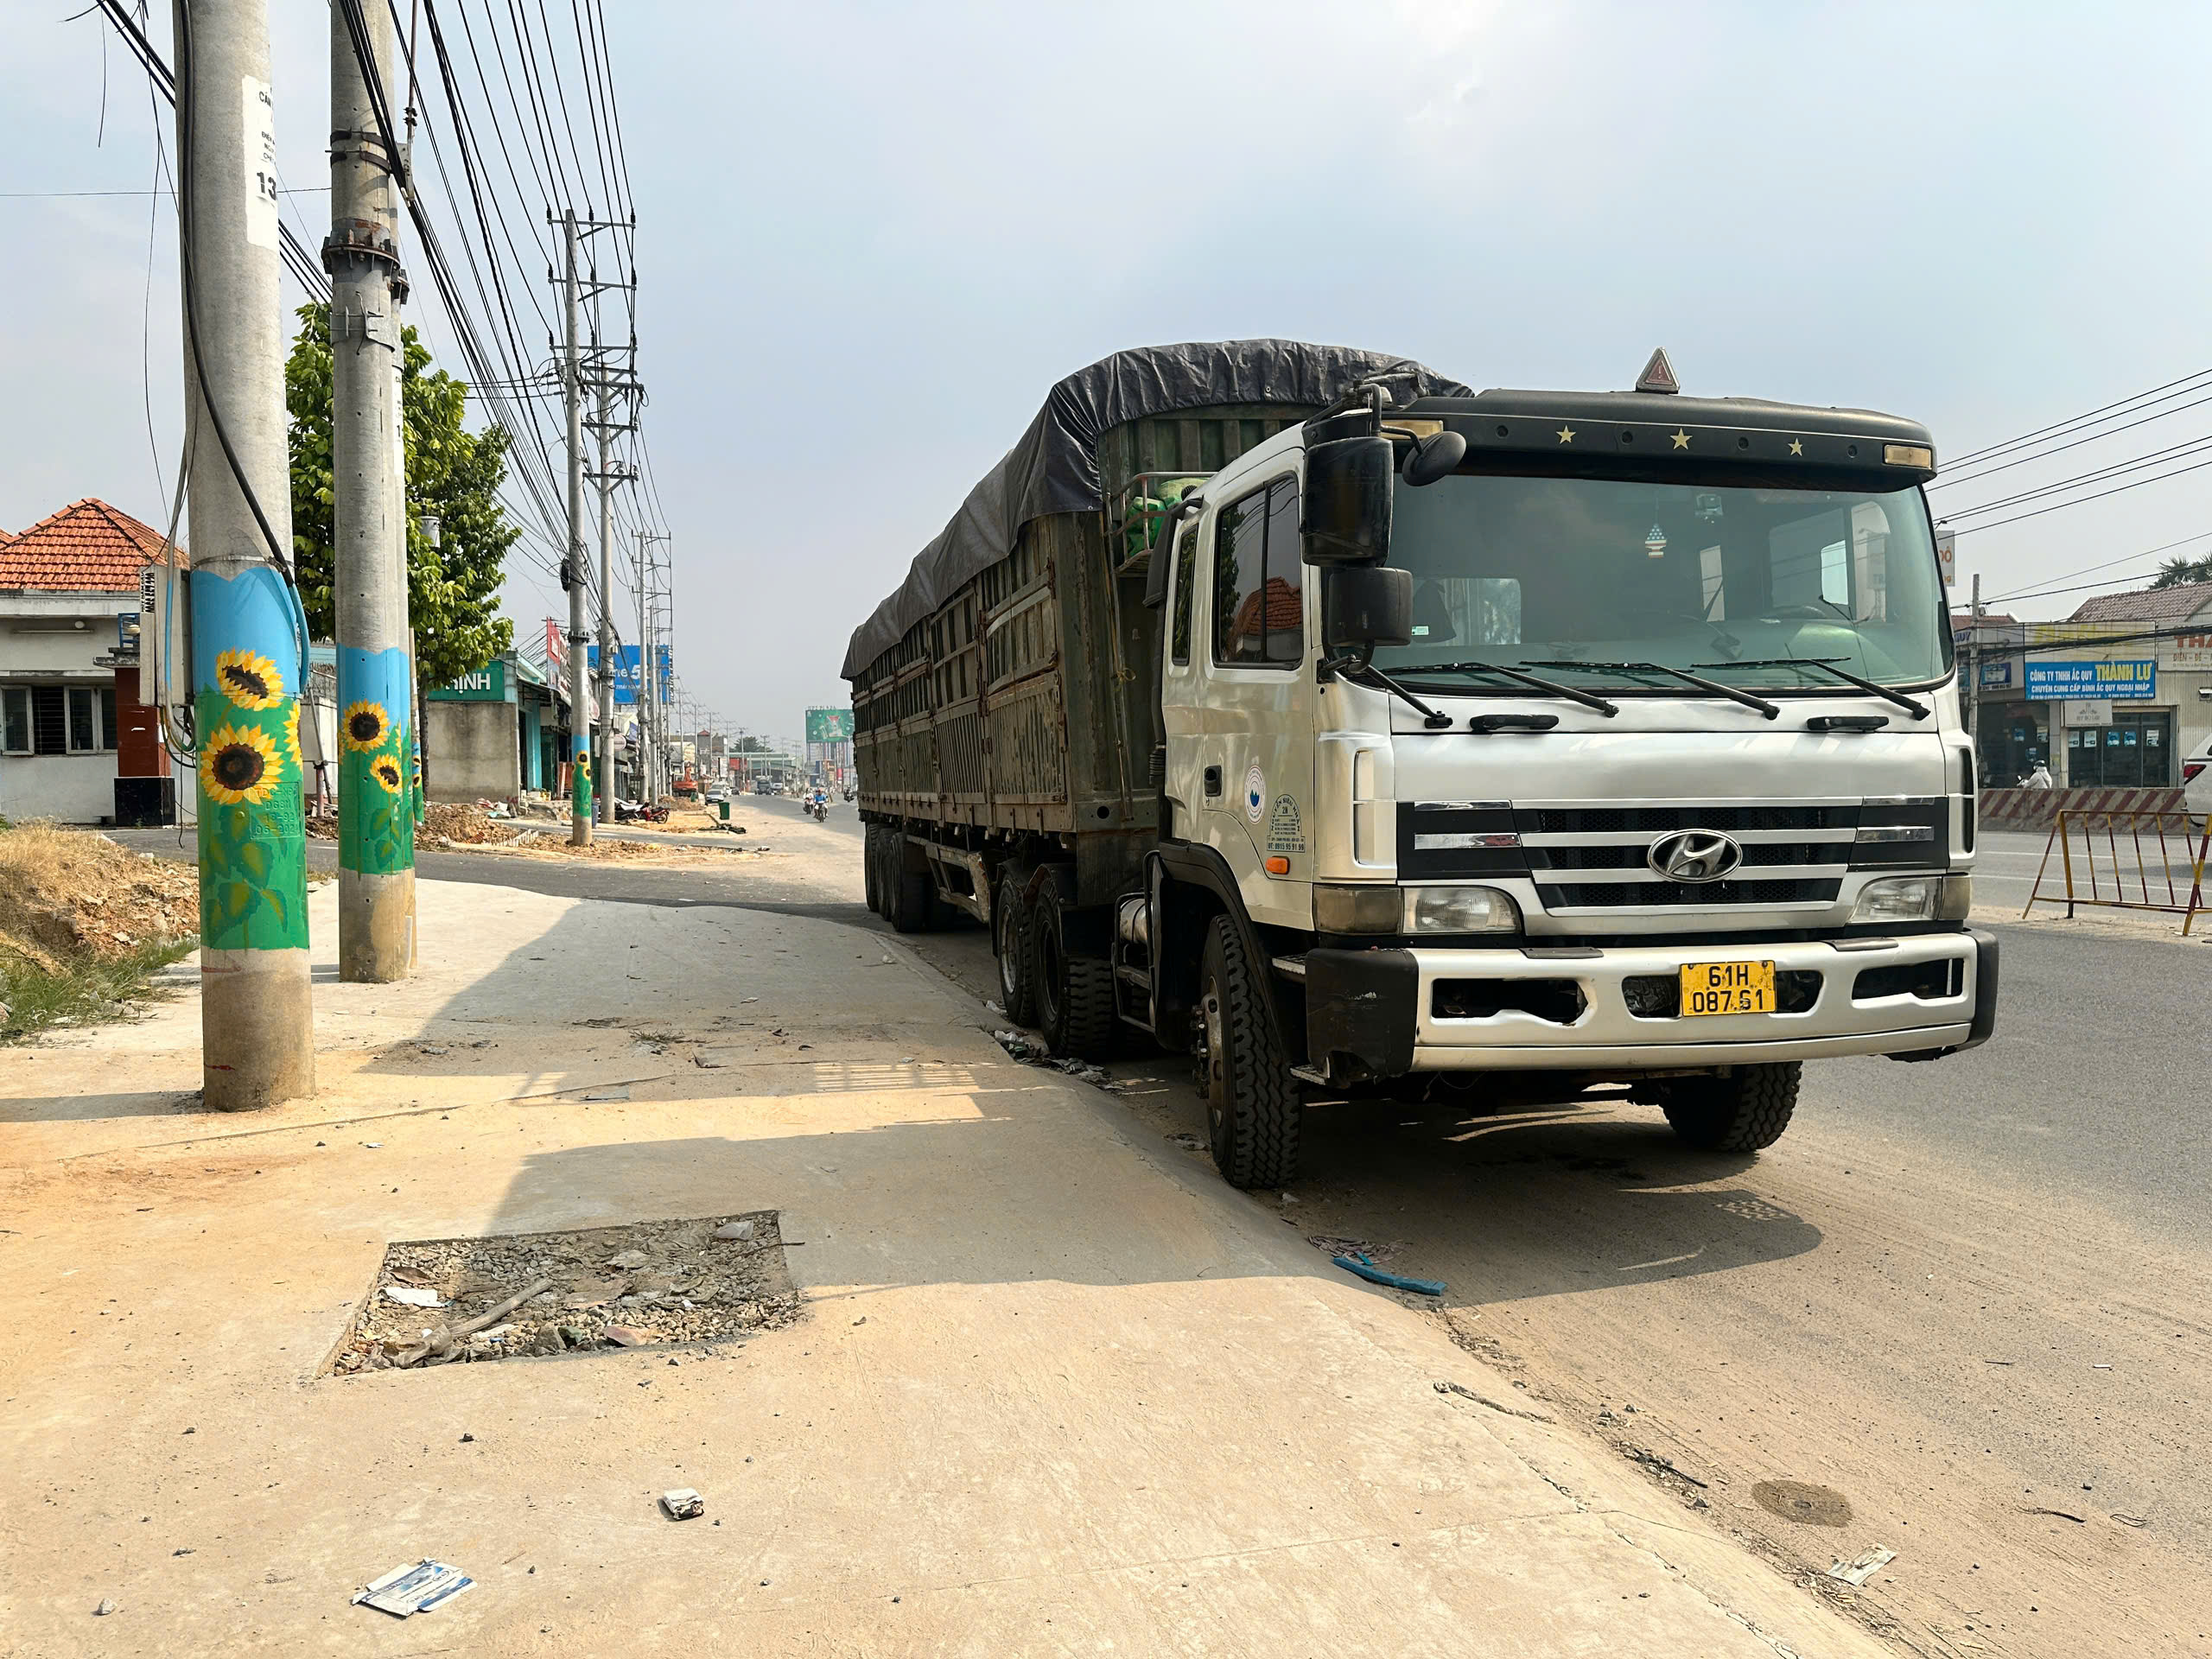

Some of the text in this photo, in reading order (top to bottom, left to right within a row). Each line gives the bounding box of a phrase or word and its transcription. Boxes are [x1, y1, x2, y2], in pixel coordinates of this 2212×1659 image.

[2030, 669, 2046, 682] CÔNG
[2046, 671, 2054, 681] TY
[2094, 661, 2134, 681] THÀNH
[2031, 683, 2053, 693] CHUYÊN
[2053, 684, 2069, 693] CUNG
[1709, 964, 1749, 988] 61H
